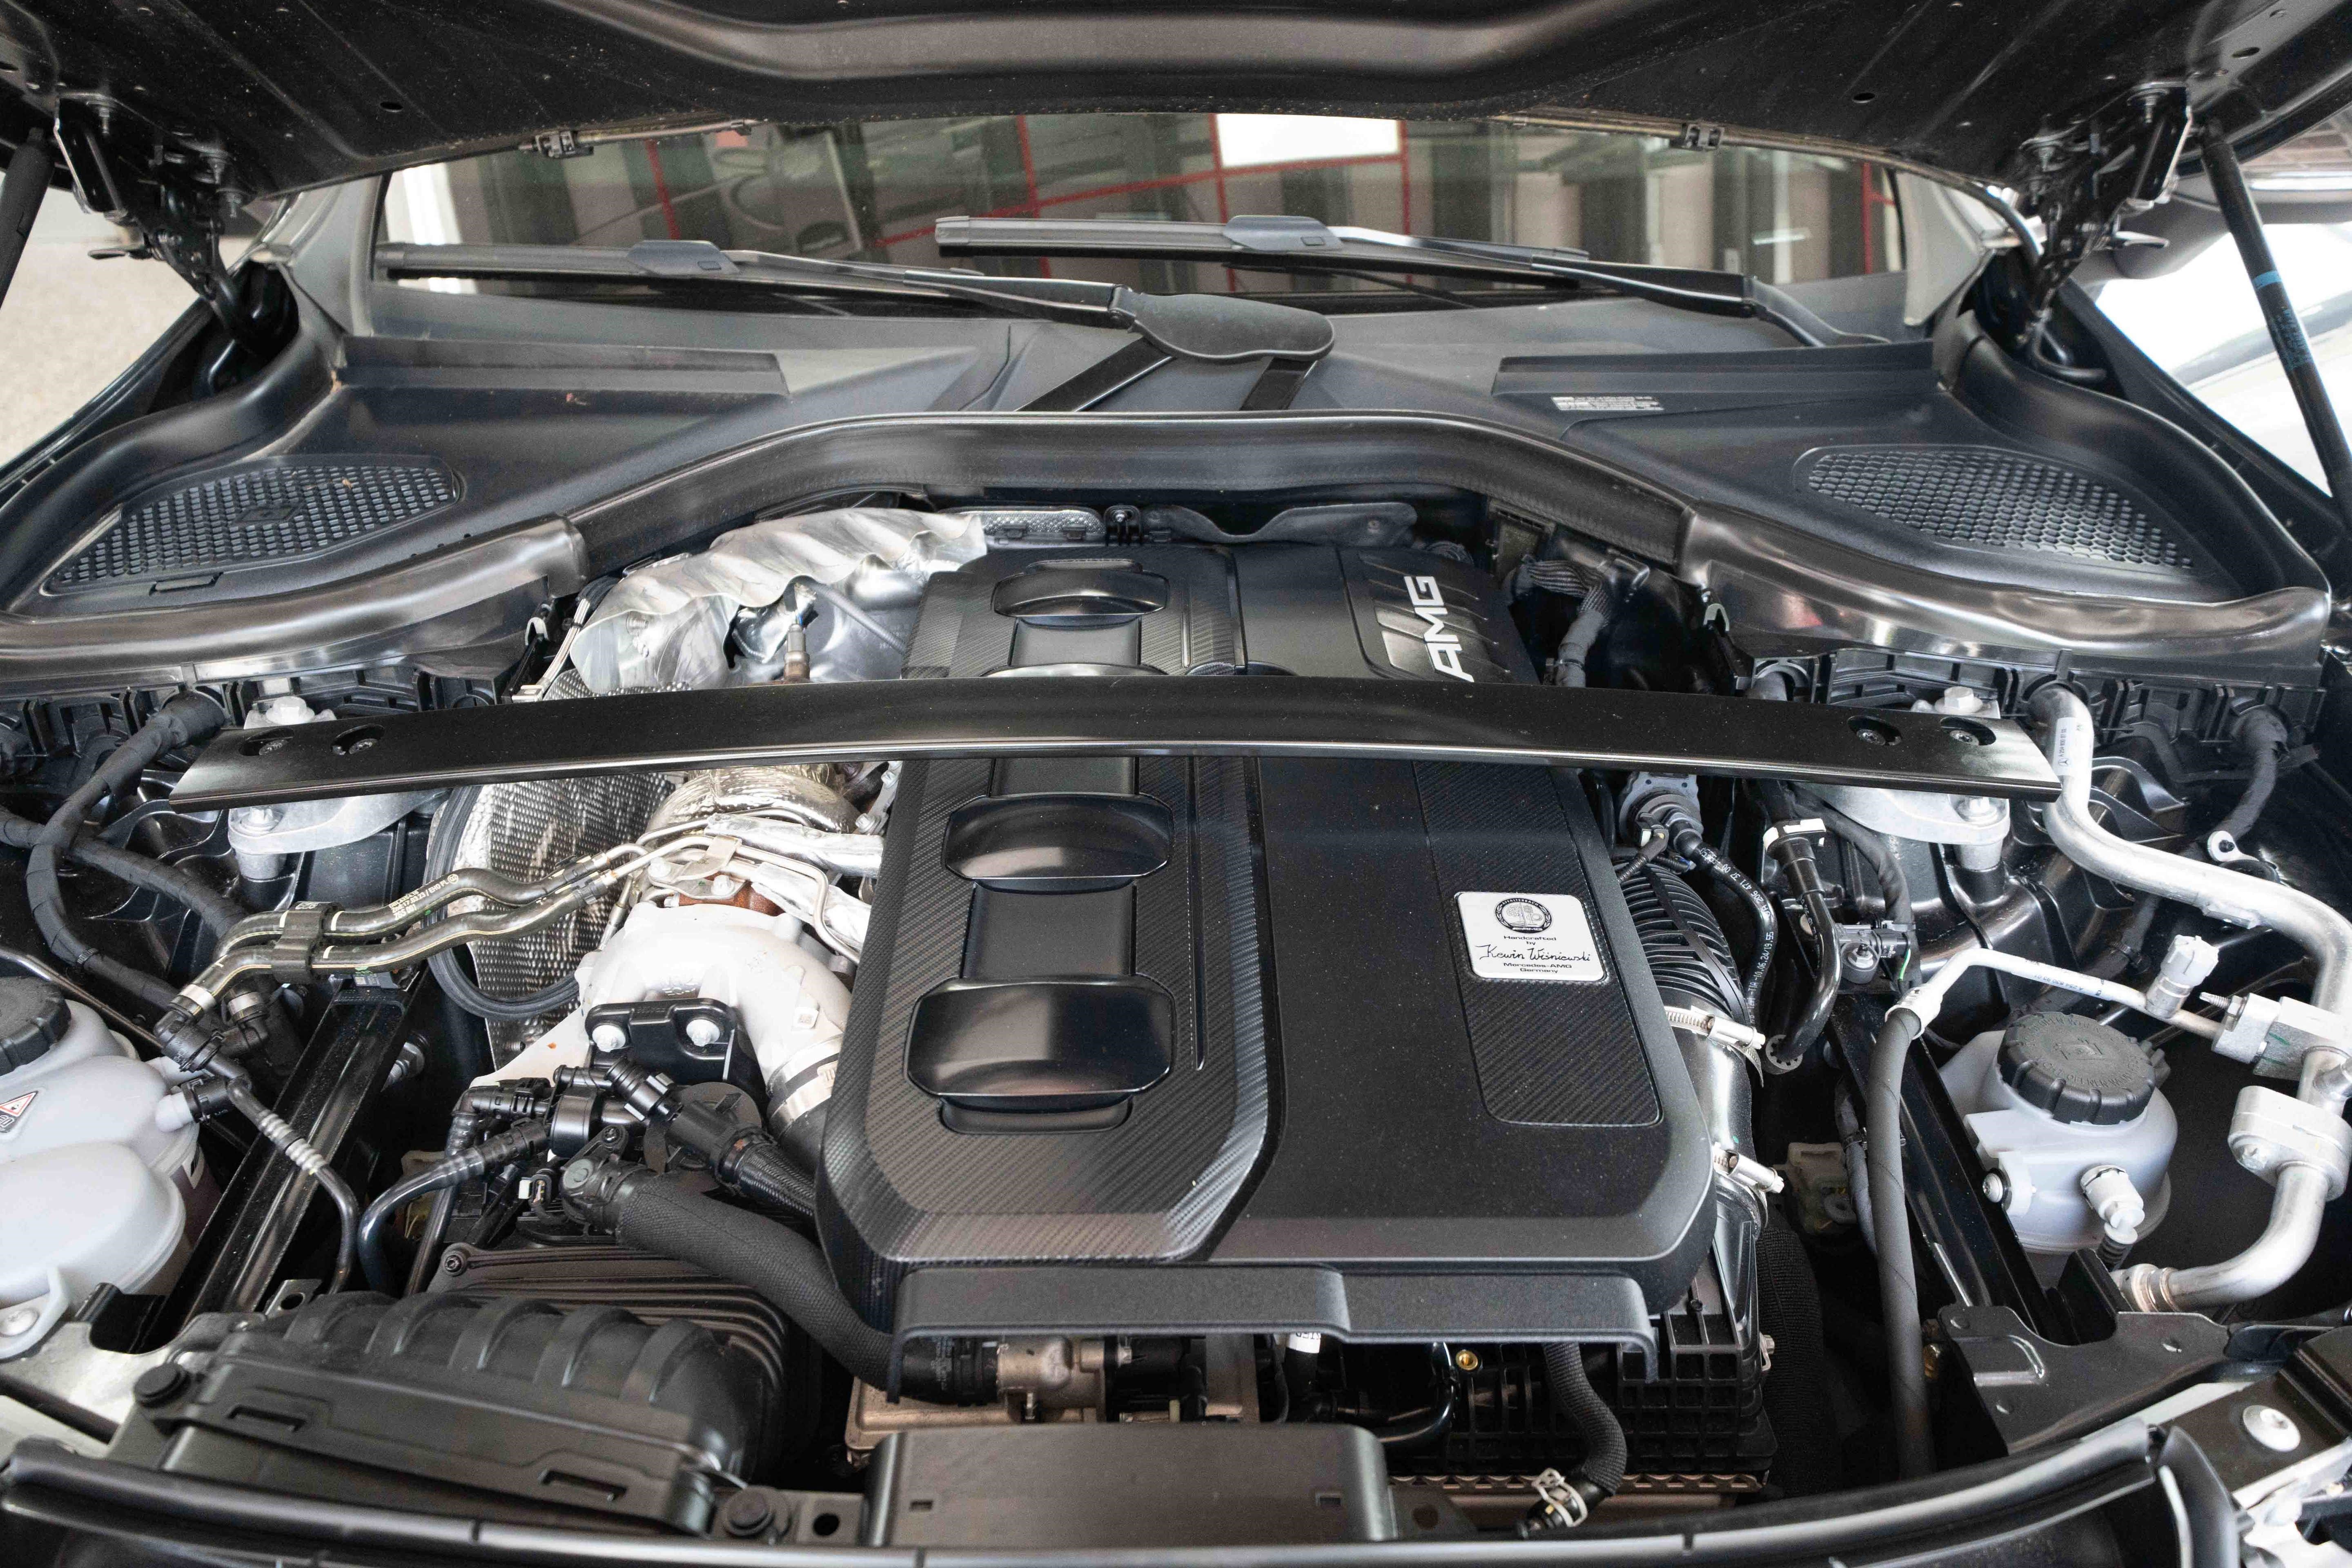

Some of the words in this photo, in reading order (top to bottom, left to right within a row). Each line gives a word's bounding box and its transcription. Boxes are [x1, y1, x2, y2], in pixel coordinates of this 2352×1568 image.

[1404, 576, 1474, 682] AMG
[1722, 864, 1731, 873] 00
[1730, 873, 1740, 881] 37
[1740, 879, 1752, 890] 471
[1751, 891, 1764, 903] 206
